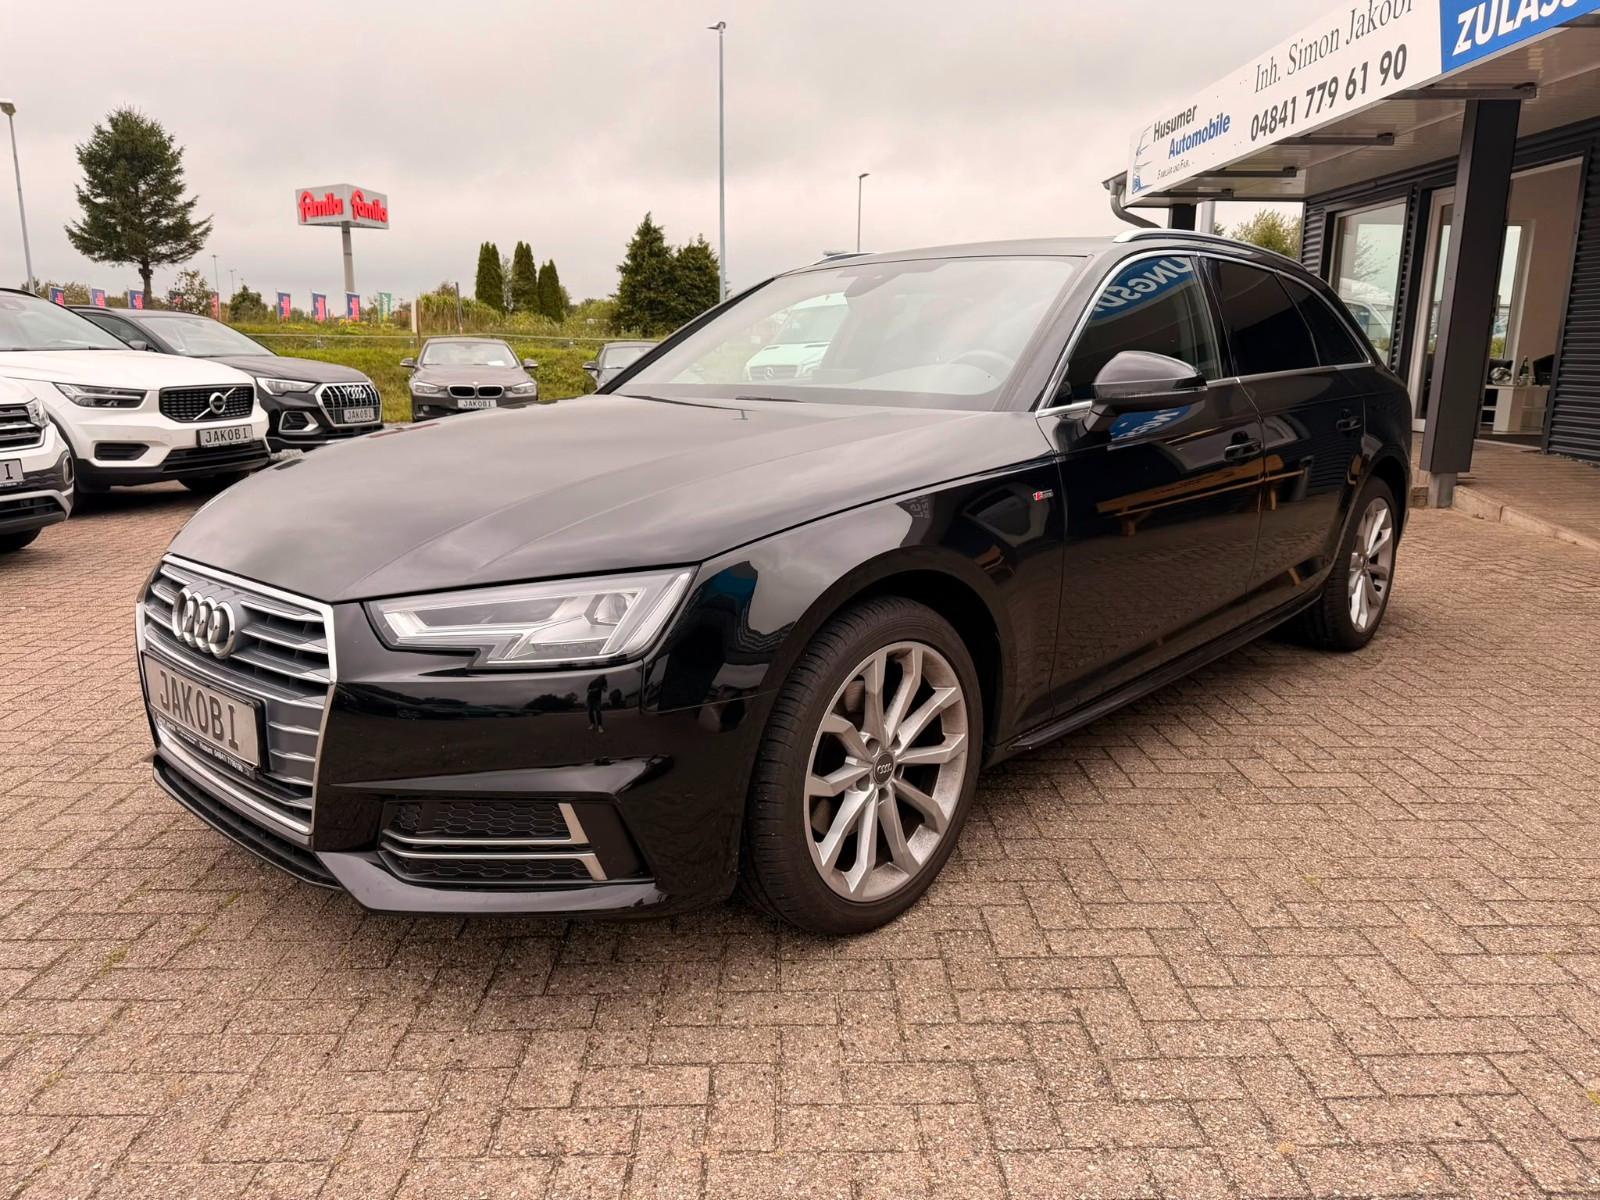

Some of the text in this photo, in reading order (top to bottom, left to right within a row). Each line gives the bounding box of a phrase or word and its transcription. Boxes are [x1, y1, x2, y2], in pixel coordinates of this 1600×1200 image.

[1254, 56, 1281, 93] Inh.
[1287, 27, 1340, 75] Simon
[1250, 43, 1407, 142] 04841 779 61 90
[1153, 104, 1198, 142] Husumer
[1168, 112, 1231, 159] Automobile
[299, 190, 344, 223] famila
[352, 189, 388, 223] famila
[205, 426, 249, 443] JAKOBI
[160, 669, 239, 752] JAKOBI
